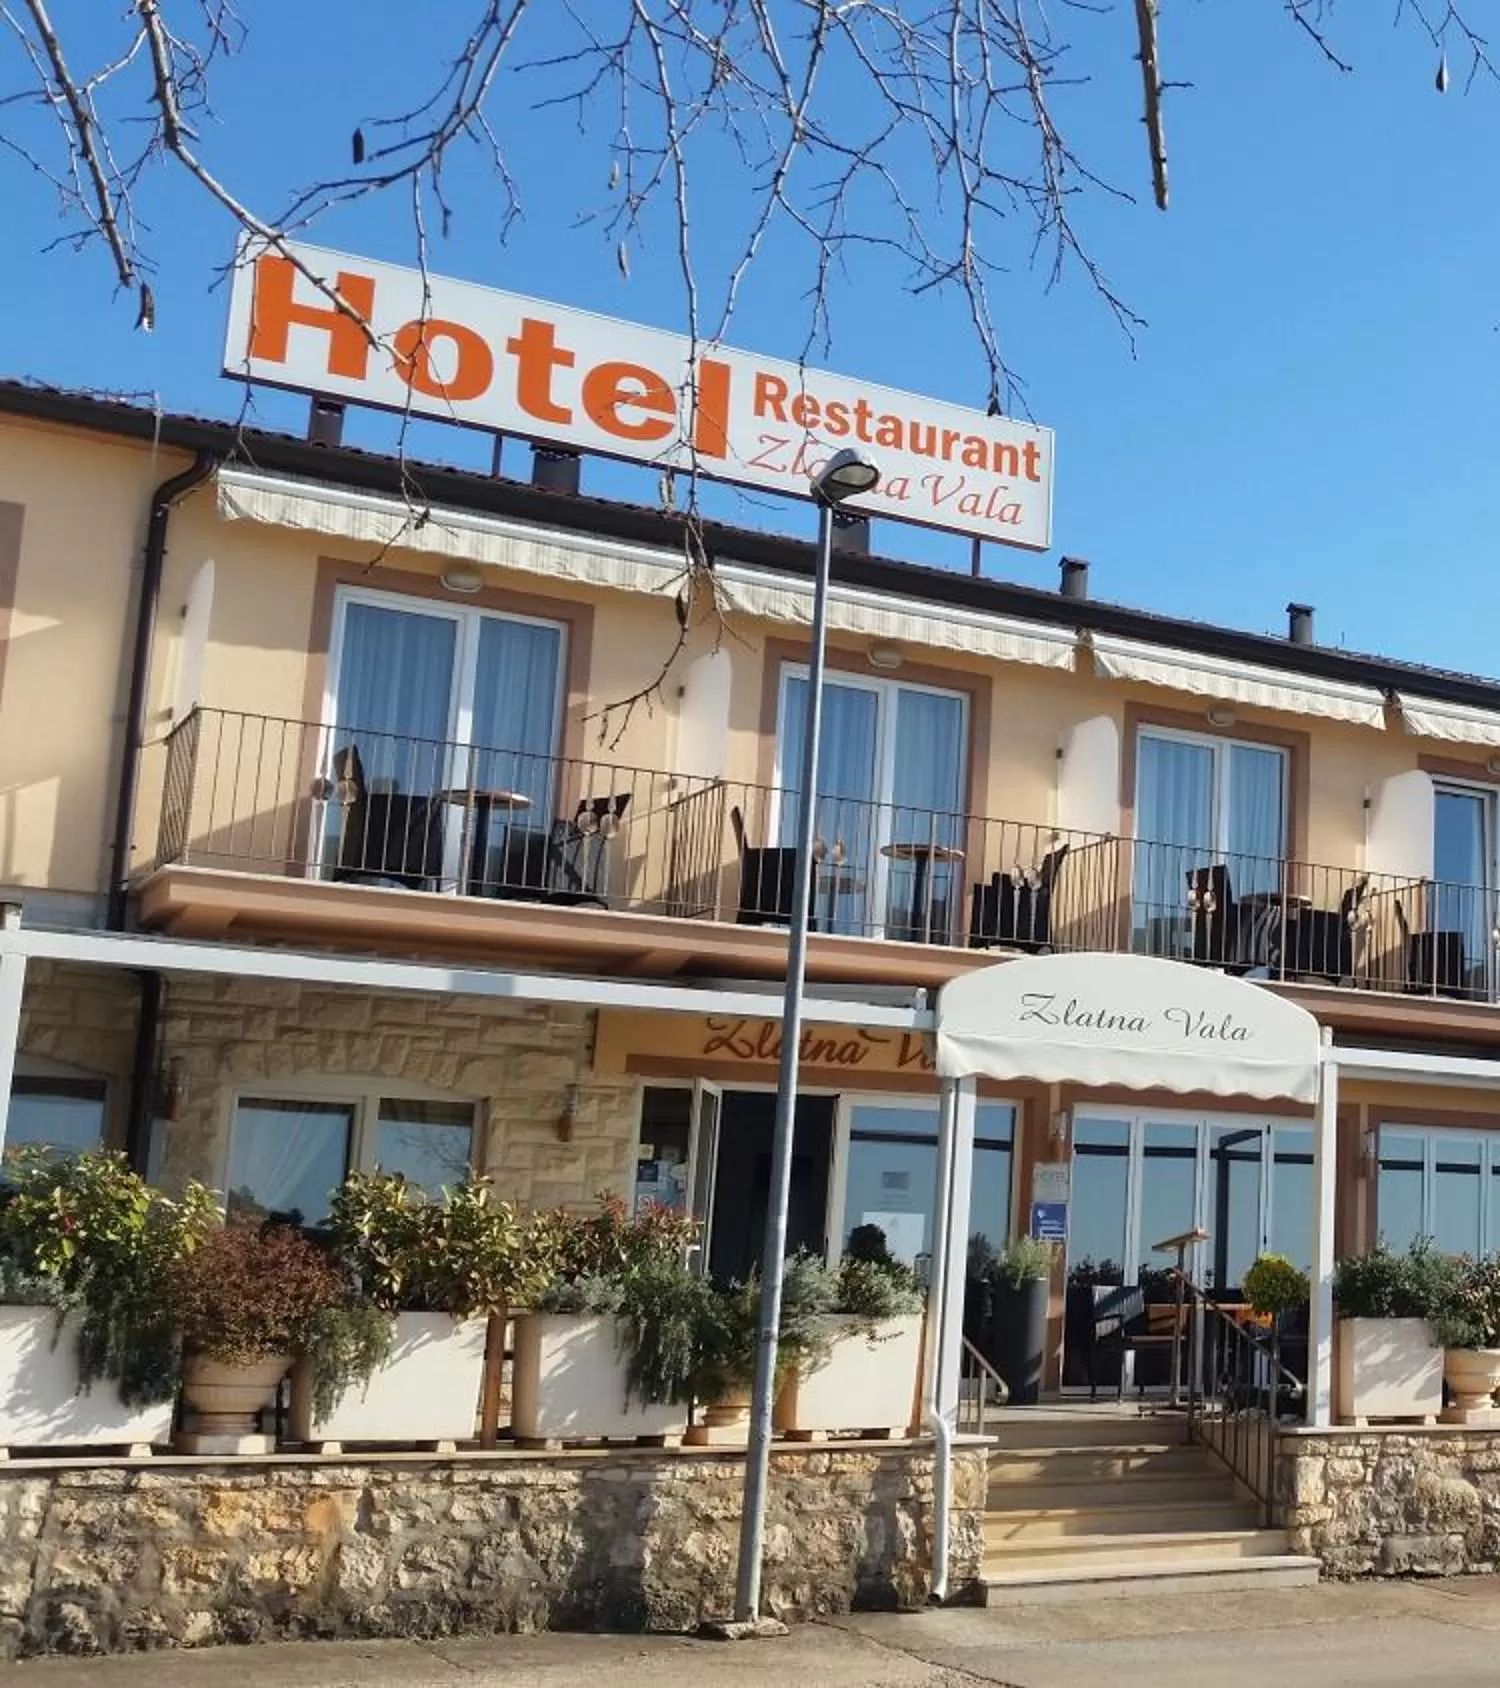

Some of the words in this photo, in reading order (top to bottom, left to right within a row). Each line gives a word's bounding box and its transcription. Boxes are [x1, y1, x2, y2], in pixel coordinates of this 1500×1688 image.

[252, 254, 731, 460] Hotel
[753, 370, 1041, 483] Restaurant
[920, 472, 1023, 526] Vala
[703, 1016, 867, 1065] Zltna
[1018, 992, 1152, 1033] Zlatna
[1164, 1007, 1250, 1041] Vala
